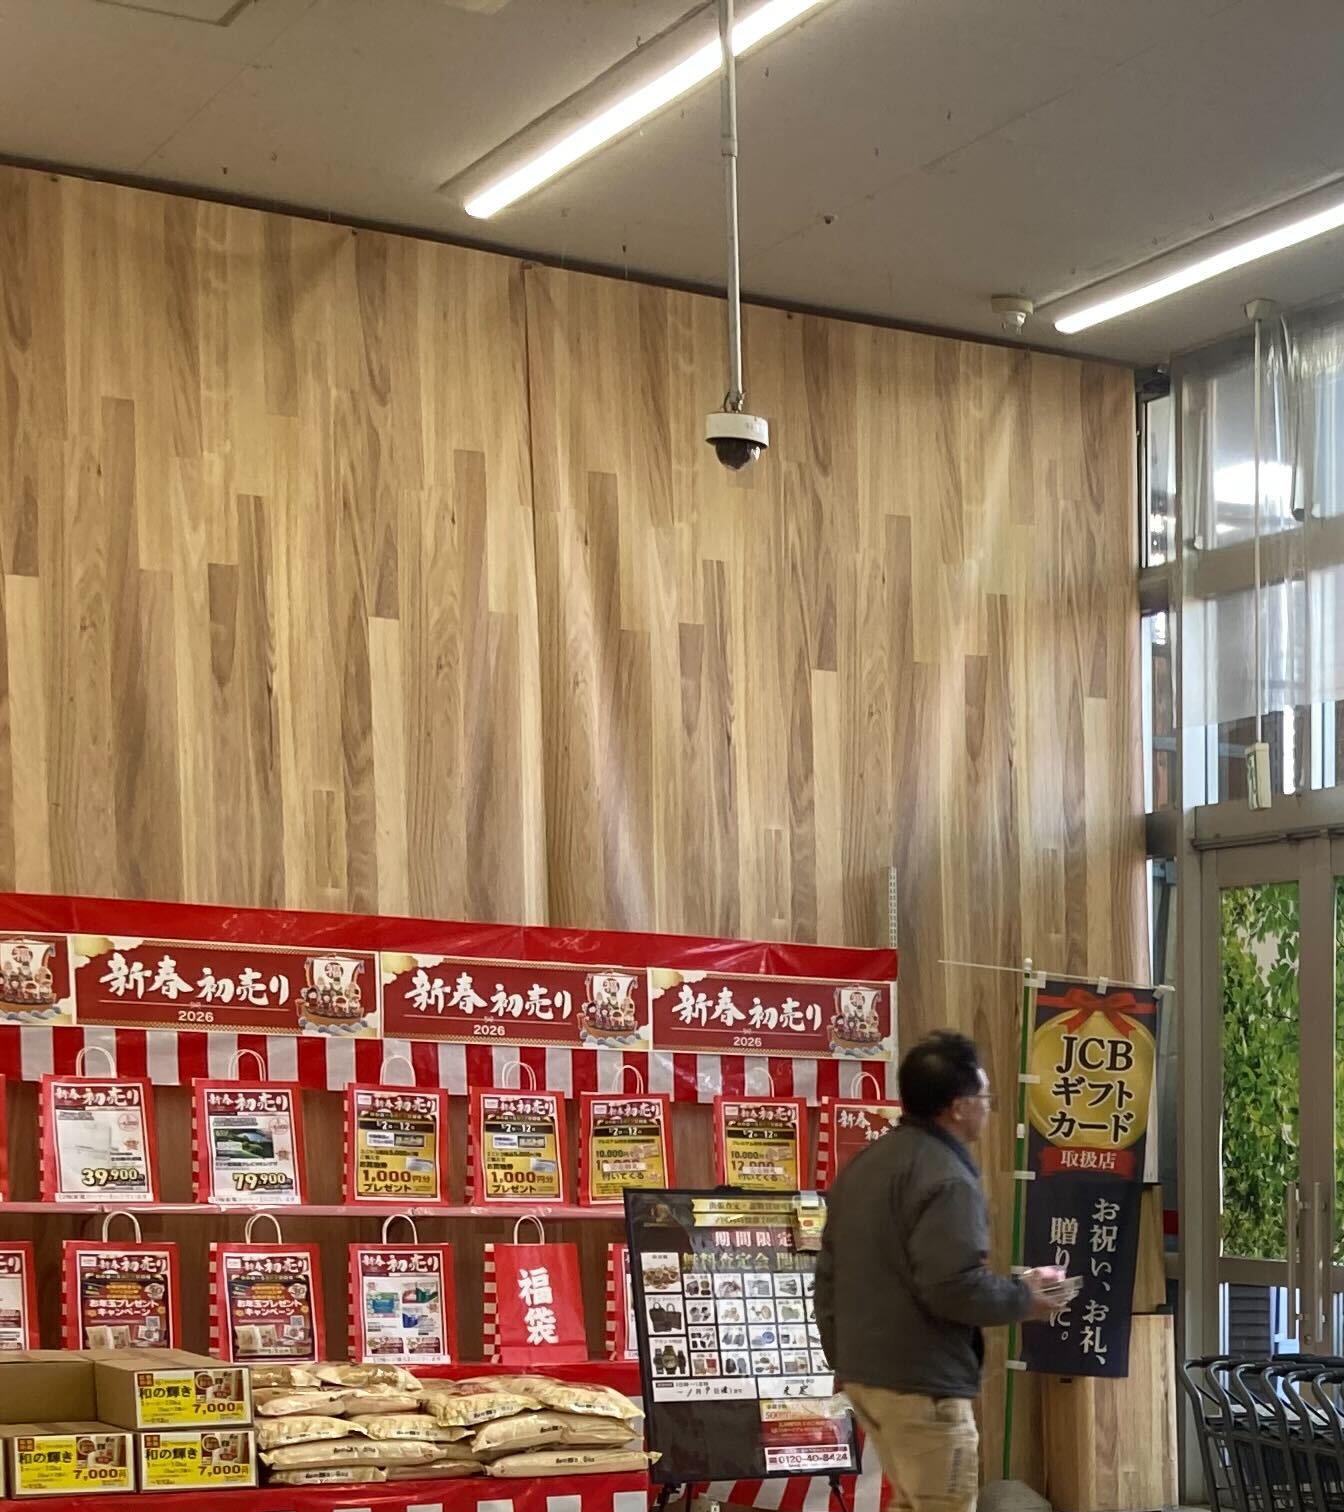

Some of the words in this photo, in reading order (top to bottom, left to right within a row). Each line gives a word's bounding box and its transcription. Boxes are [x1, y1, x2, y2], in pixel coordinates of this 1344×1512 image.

[178, 1010, 214, 1023] 2026
[473, 1025, 506, 1037] 2026
[733, 1036, 763, 1048] 2026
[1055, 1035, 1135, 1075] JCB
[1052, 1075, 1135, 1110] ギフト
[1047, 1110, 1136, 1144] カード
[1060, 1149, 1118, 1170] 取扱店
[714, 1230, 793, 1248] 期間限定
[1048, 1216, 1080, 1342] 贈りに。
[516, 1266, 561, 1346] 福袋
[192, 1402, 245, 1415] 7,000円
[198, 1464, 250, 1478] 7,000円
